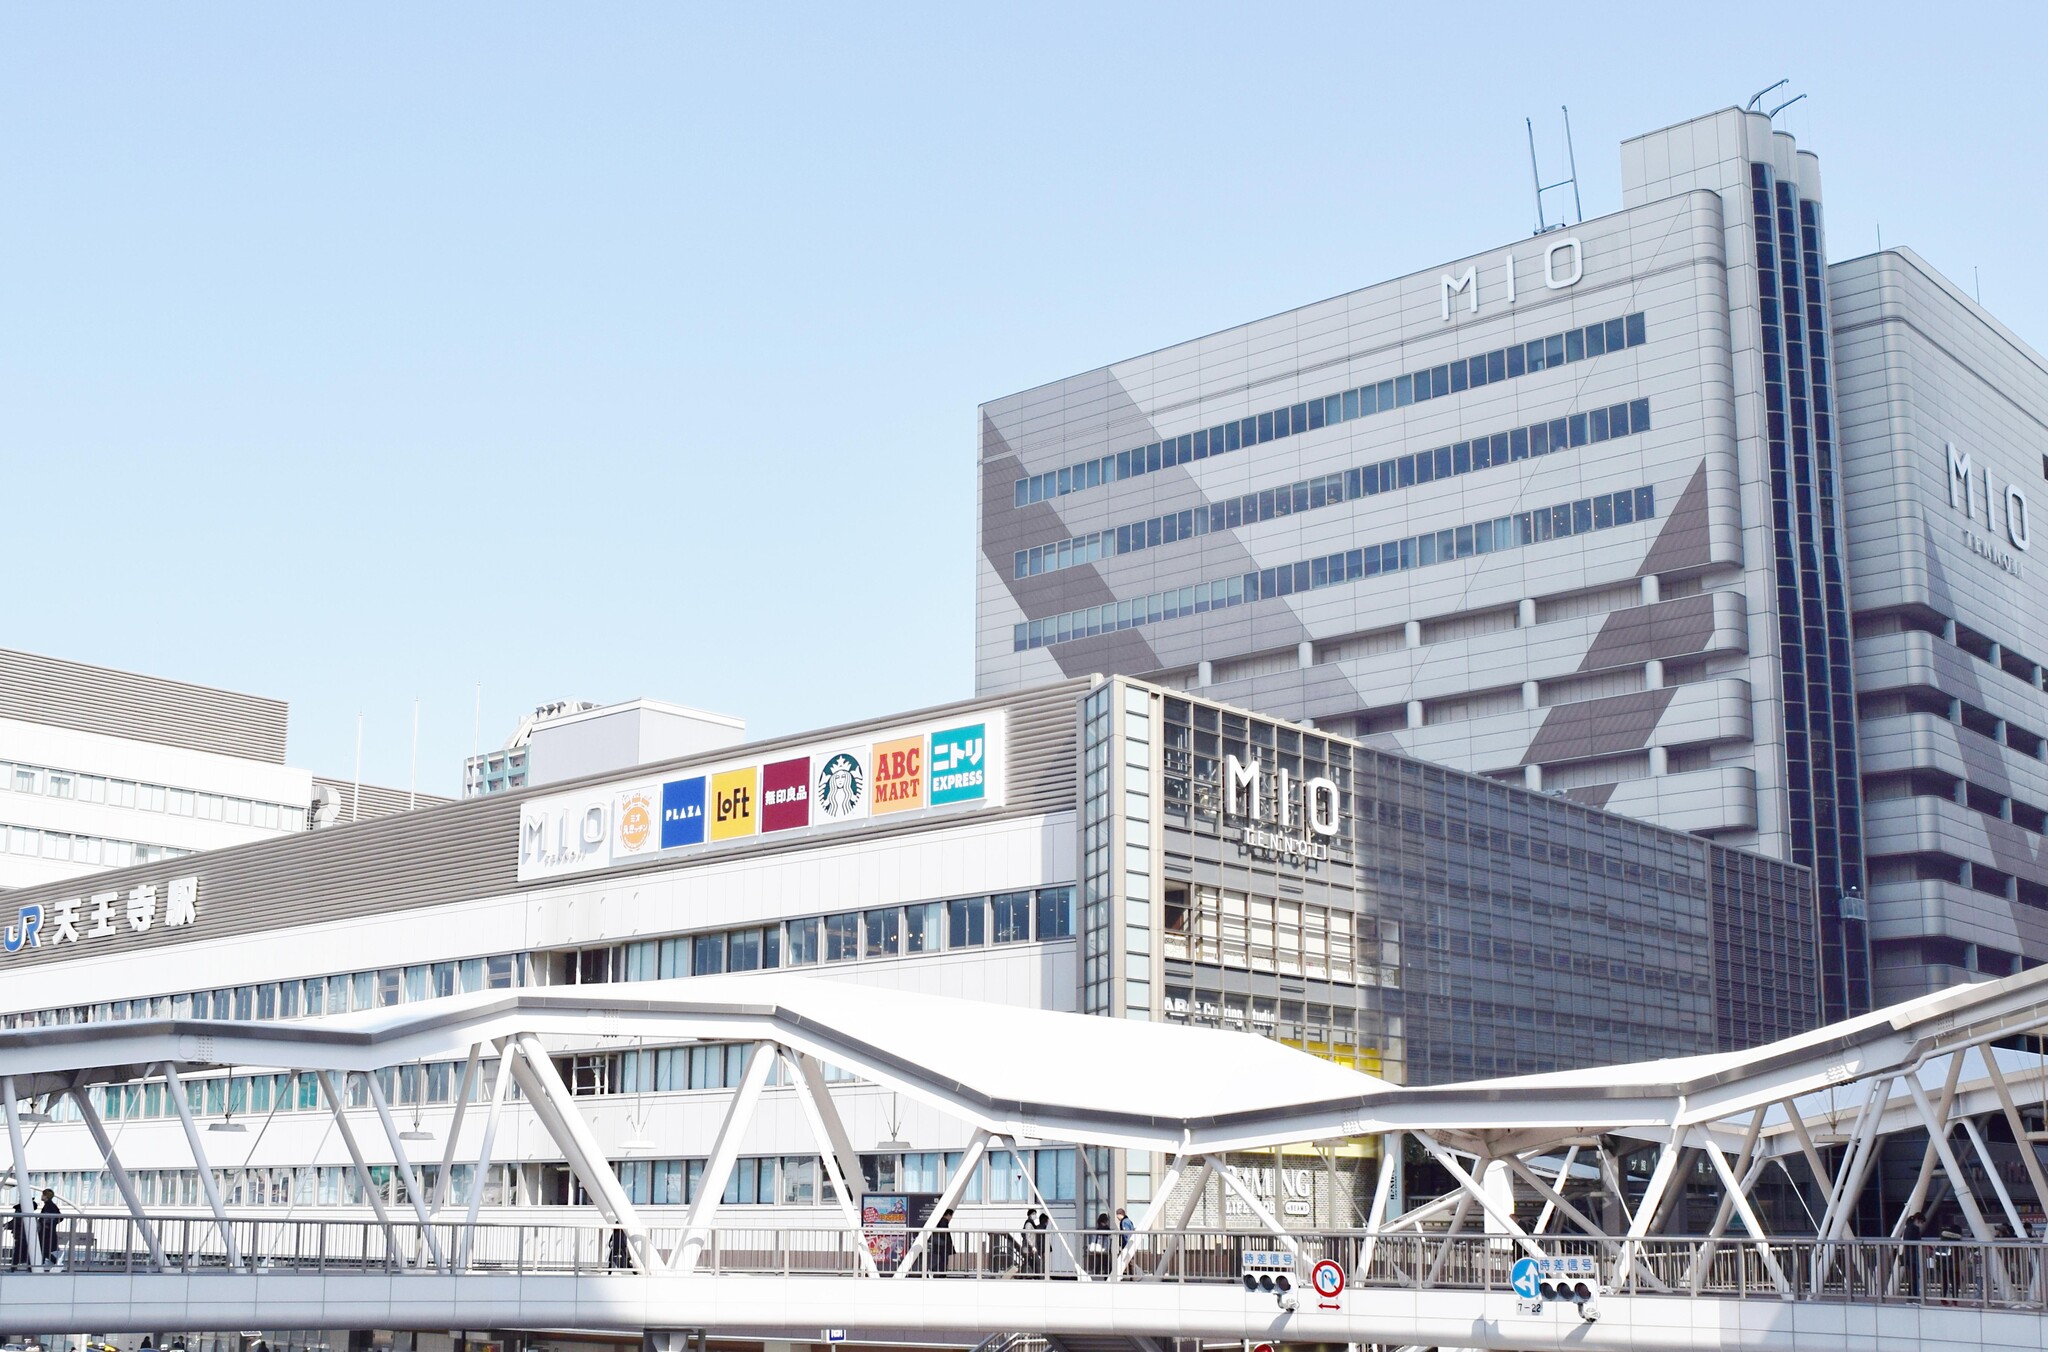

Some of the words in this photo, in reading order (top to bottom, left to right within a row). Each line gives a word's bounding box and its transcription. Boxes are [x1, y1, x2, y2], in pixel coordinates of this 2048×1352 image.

[1441, 237, 1583, 321] MIO
[1946, 441, 2030, 551] MIO
[875, 747, 920, 782] ABC
[933, 738, 983, 772] ニトリ
[765, 785, 807, 806] 無印良品
[875, 778, 920, 803] MART
[933, 770, 983, 792] EXPRESS
[1225, 754, 1339, 836] MIO
[525, 803, 606, 855] MIO
[666, 805, 702, 821] PLAZA
[1244, 827, 1326, 860] TENNOJI
[4, 904, 45, 952] JR
[52, 876, 200, 945] 天王寺駅
[1204, 1002, 1243, 1027] Coing
[1244, 1253, 1292, 1266] 時差信号
[1540, 1258, 1592, 1272] 時差信号
